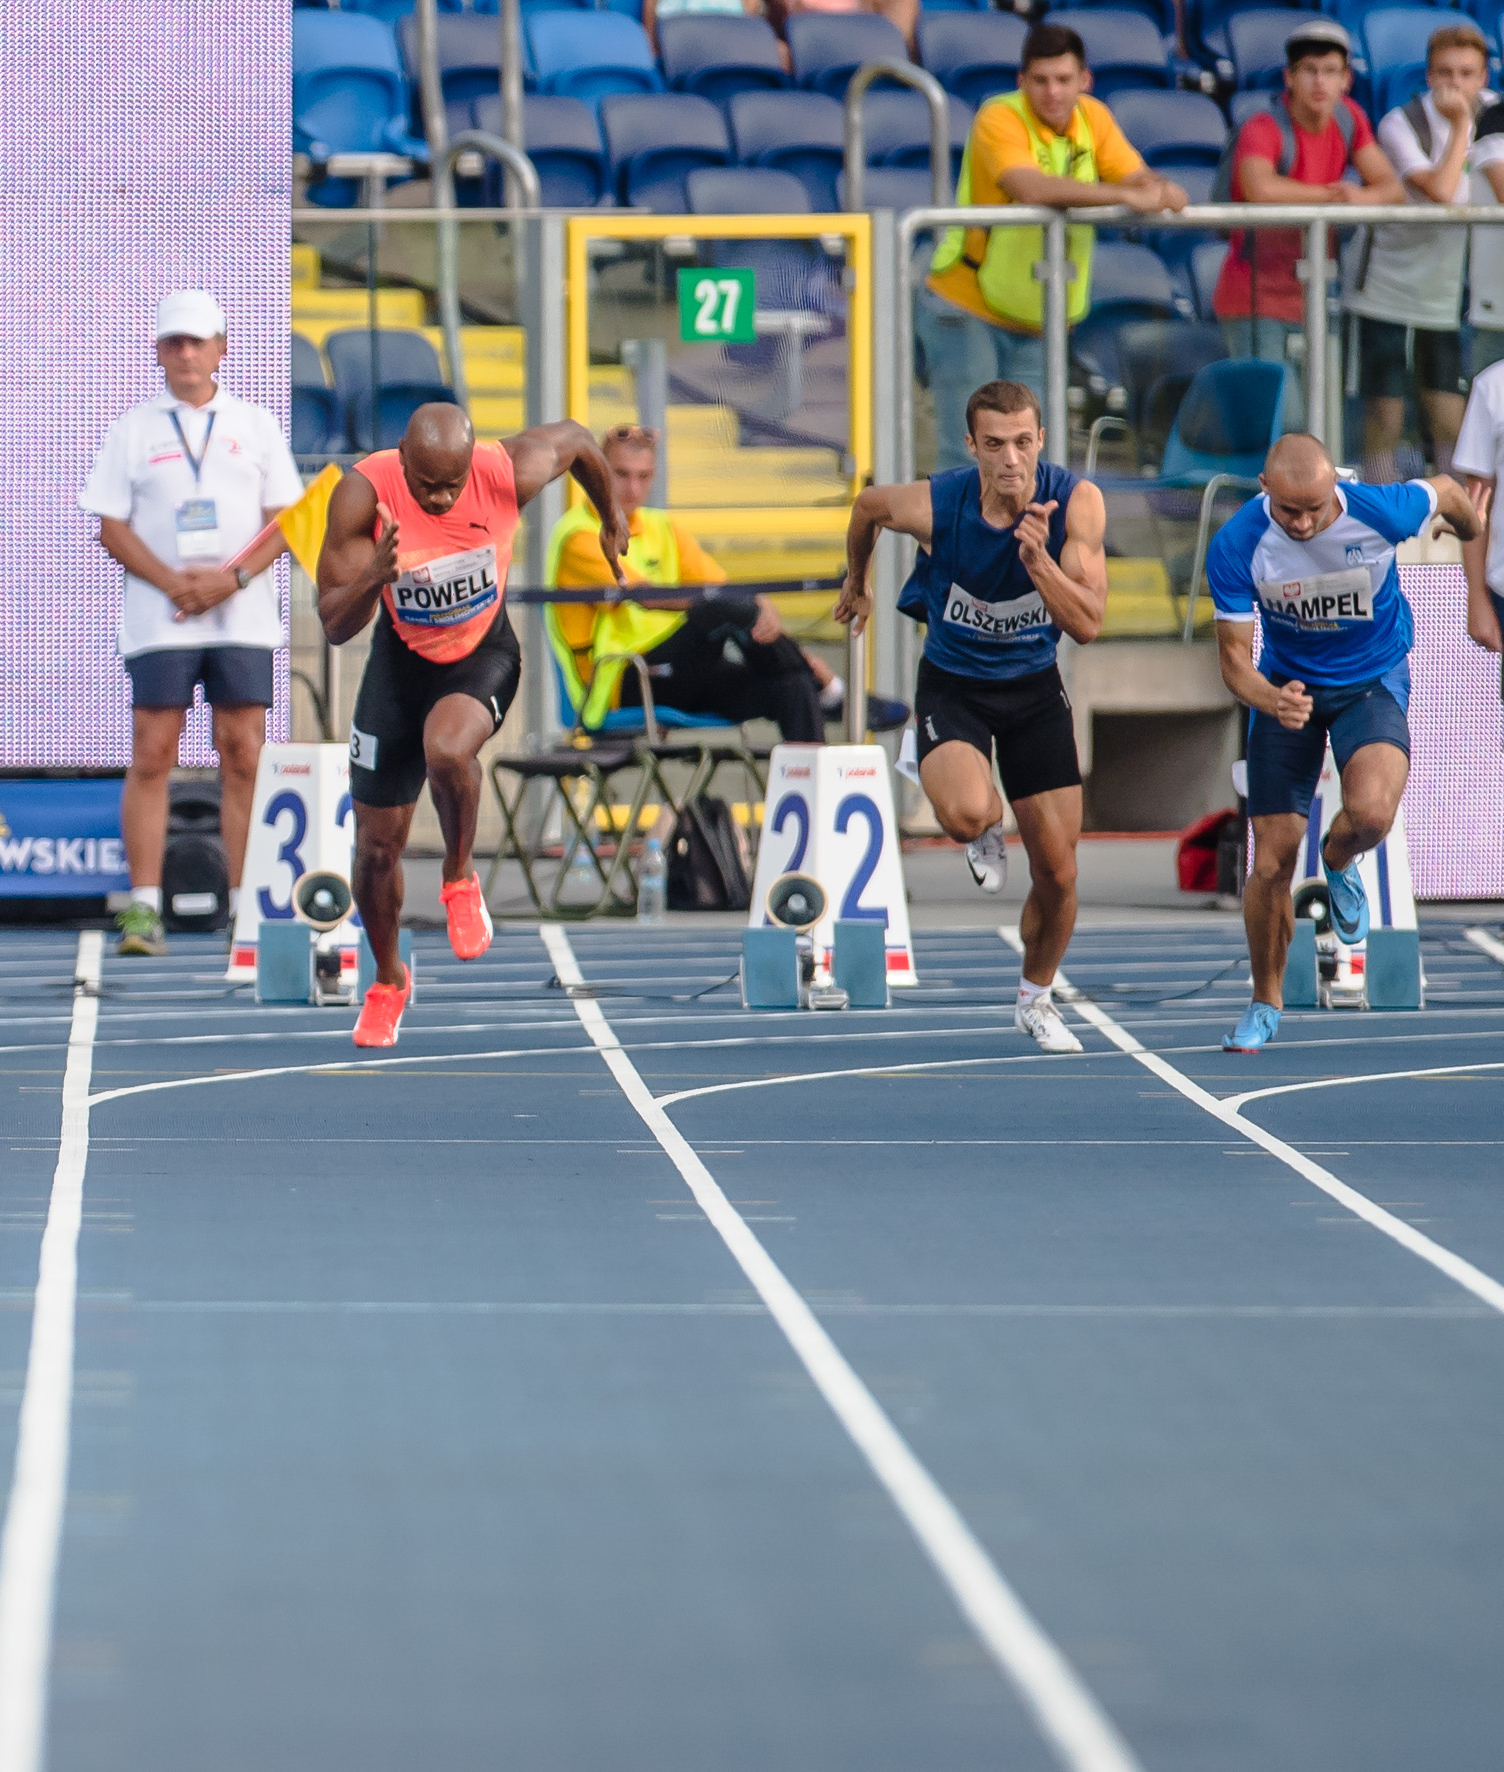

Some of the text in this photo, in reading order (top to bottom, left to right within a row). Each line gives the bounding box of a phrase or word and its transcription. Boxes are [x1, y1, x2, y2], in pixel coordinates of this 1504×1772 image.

[694, 279, 742, 335] 27
[397, 568, 494, 609] POWELL
[1266, 592, 1367, 620] HAMPEL
[950, 600, 1047, 633] OLSZEWSKI
[258, 790, 307, 919] 3
[835, 793, 889, 929] 2
